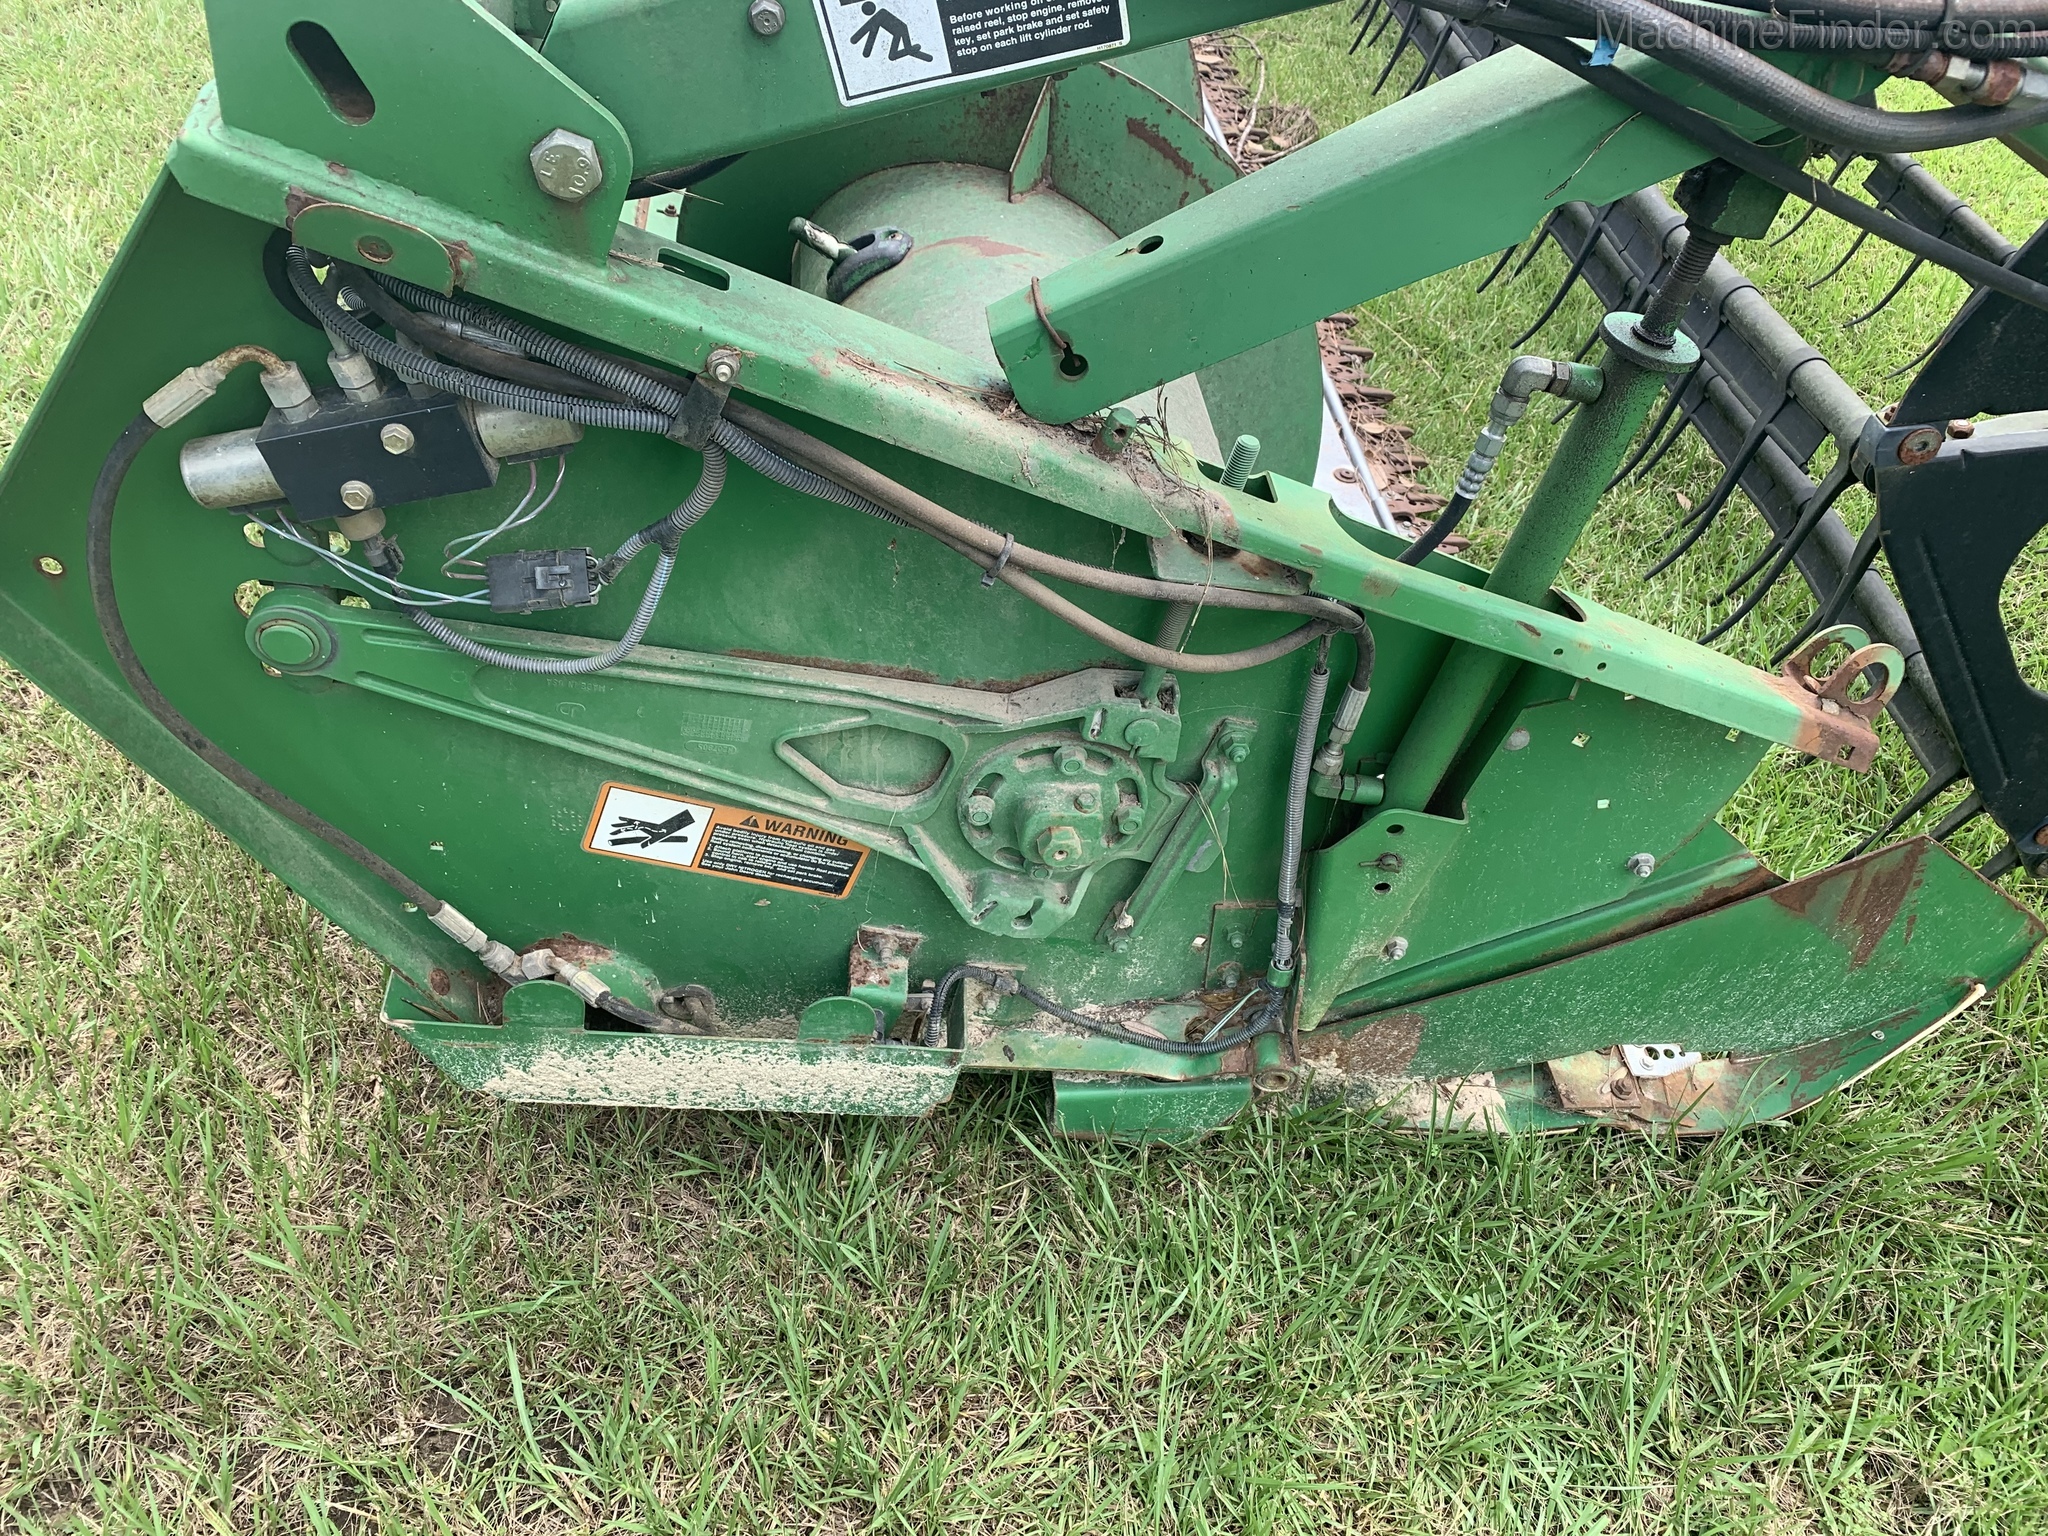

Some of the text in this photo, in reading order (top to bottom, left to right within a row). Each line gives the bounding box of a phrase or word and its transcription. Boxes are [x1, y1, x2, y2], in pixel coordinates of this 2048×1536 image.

[949, 11, 983, 24] Before
[985, 1, 1028, 17] working
[952, 21, 982, 35] raised
[984, 16, 1005, 29] reel,
[1007, 12, 1028, 23] stop
[1030, 4, 1065, 18] engine,
[954, 4, 1110, 46] key, set park brake and set safety
[956, 19, 1093, 57] stop on each lift cylinder rod.
[568, 157, 592, 195] 10.9
[764, 819, 849, 846] WARNING
